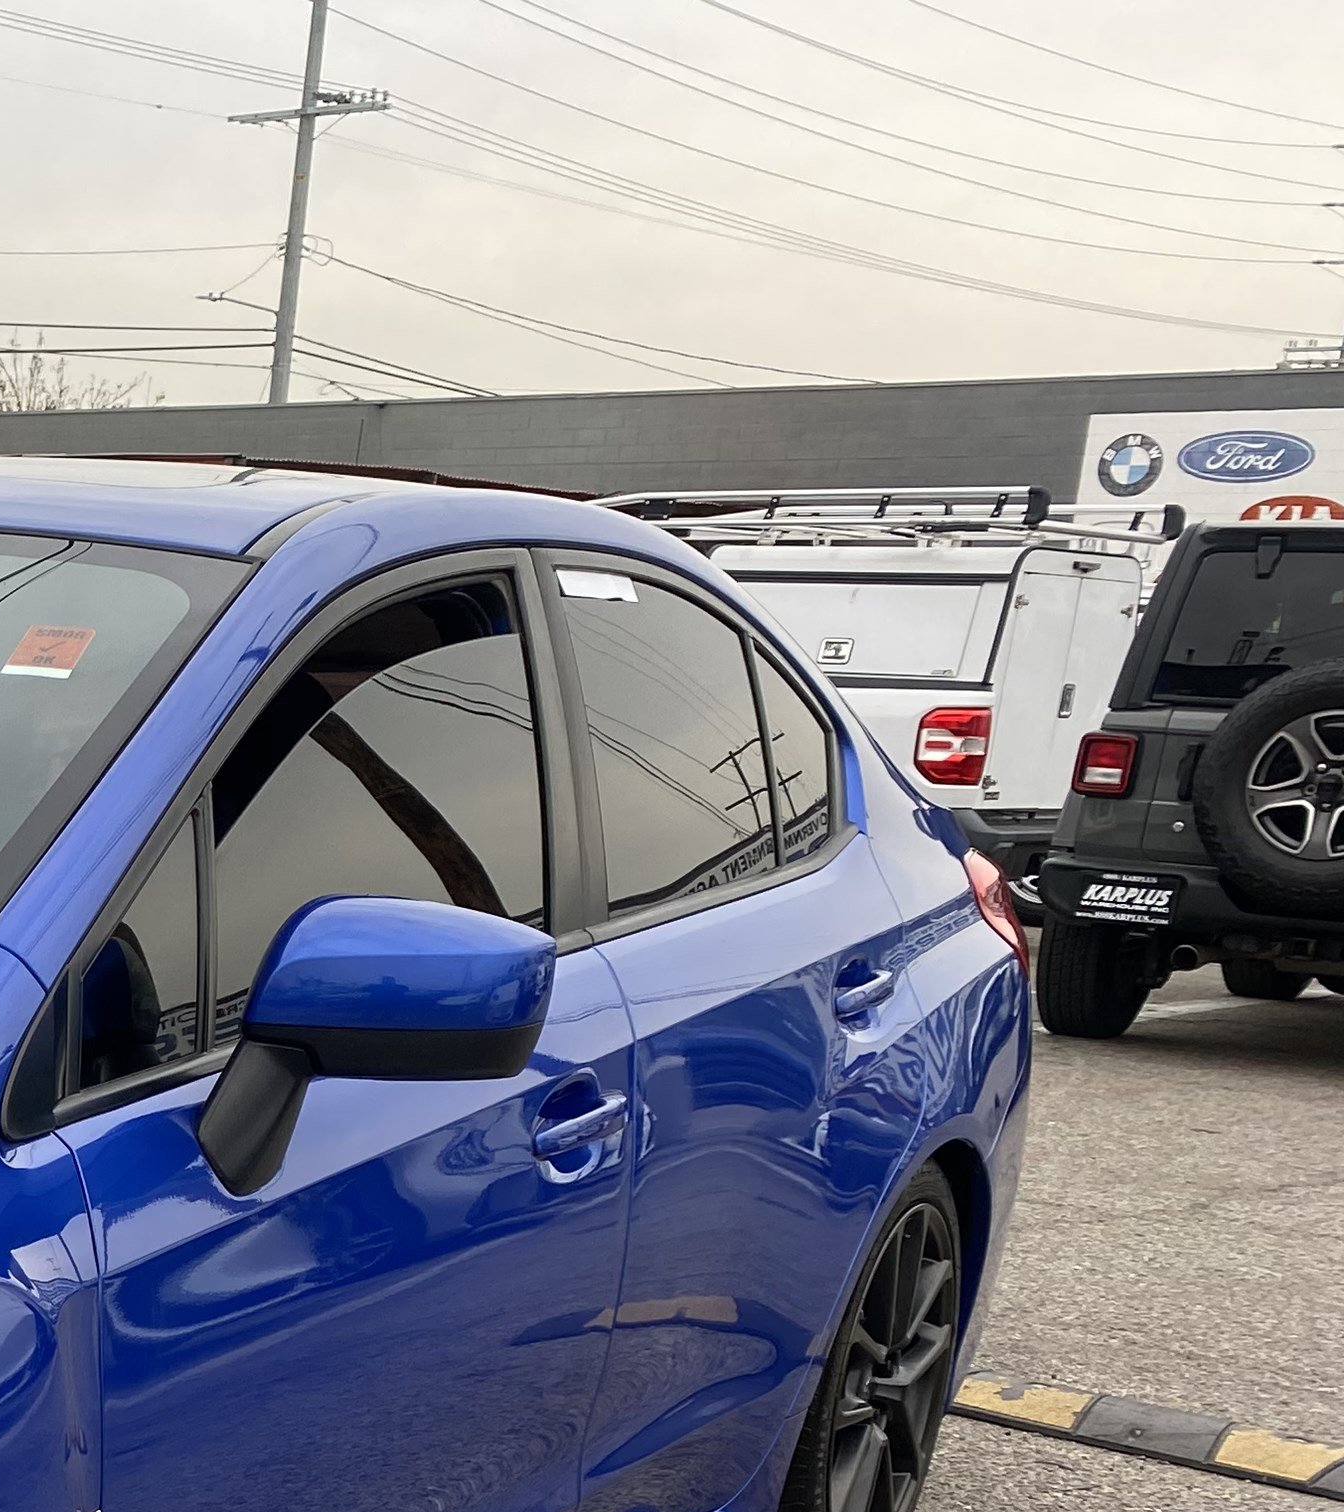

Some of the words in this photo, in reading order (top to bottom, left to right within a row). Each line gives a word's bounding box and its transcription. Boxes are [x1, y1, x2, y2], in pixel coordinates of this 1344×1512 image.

[1103, 435, 1162, 462] BMW
[1206, 440, 1286, 471] Ford
[1259, 505, 1332, 520] KIA
[1083, 884, 1173, 906] KARPLUS
